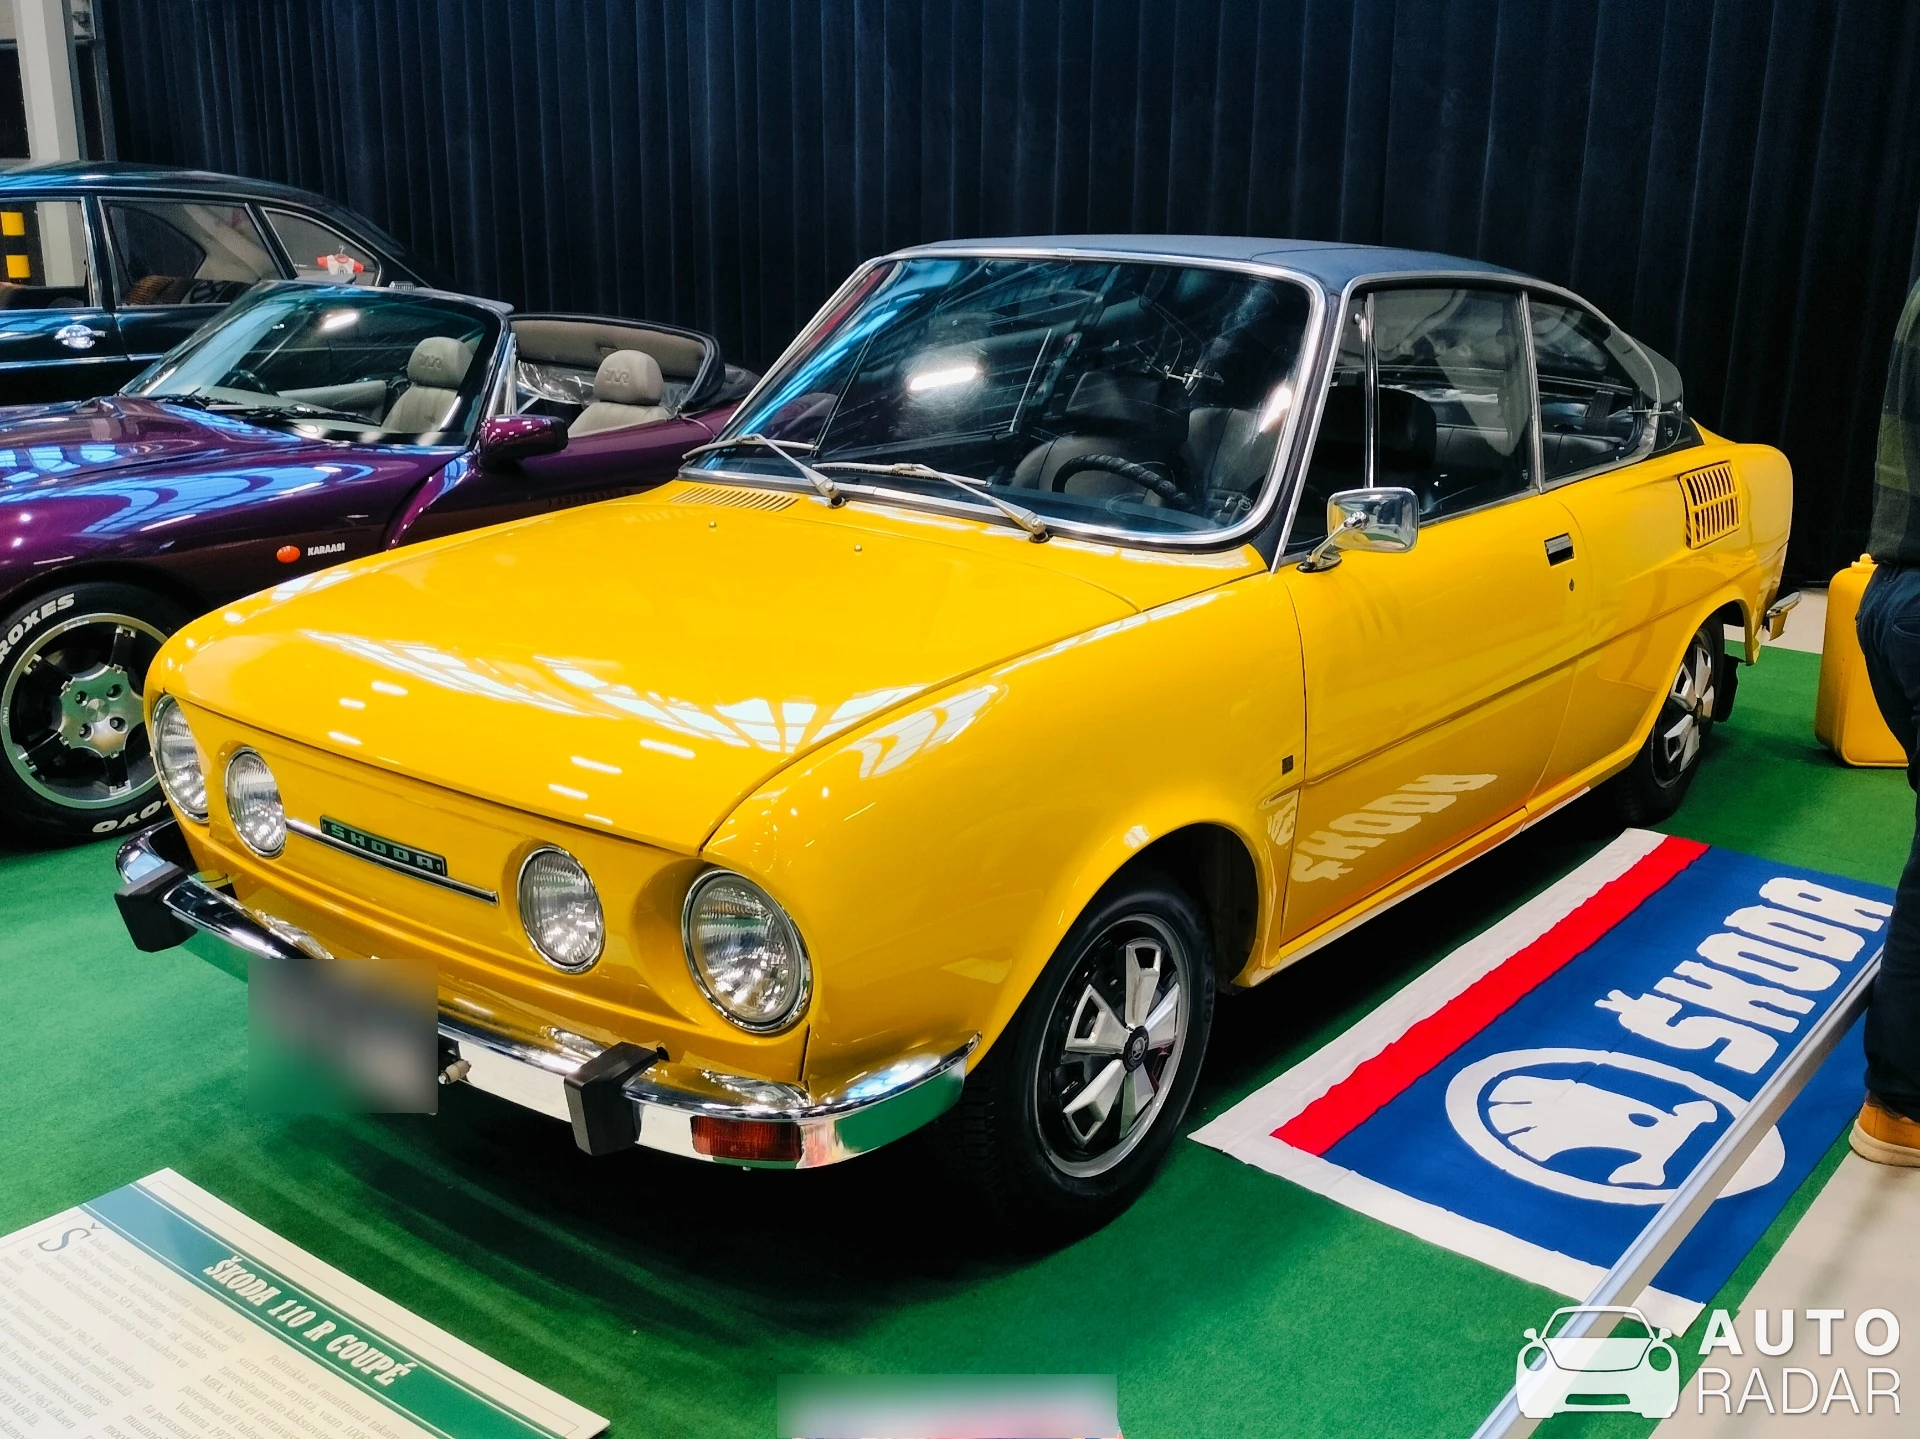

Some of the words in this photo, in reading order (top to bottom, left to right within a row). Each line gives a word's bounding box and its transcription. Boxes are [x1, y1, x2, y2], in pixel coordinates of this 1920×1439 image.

[307, 542, 346, 557] KARAASI
[0, 593, 75, 664] ROXES
[91, 800, 170, 834] OYO
[1595, 877, 1894, 1074] ŠKODA
[202, 1255, 282, 1307] ŠKODA
[267, 1299, 317, 1328] 110
[303, 1320, 336, 1342] R
[326, 1334, 418, 1386] COUPÉ
[106, 1356, 154, 1390] autokauppa
[178, 1385, 224, 1416] parempaa
[218, 1366, 269, 1401] tuoreeltaan
[265, 1398, 287, 1413] aito
[284, 1409, 334, 1439] kaksiovin
[236, 1357, 287, 1392] siirtymisen
[318, 1410, 343, 1429] vaan
[266, 1354, 309, 1385] Politiikka
[318, 1389, 371, 1423] muuttunut
[175, 1401, 210, 1429] Vuonna
